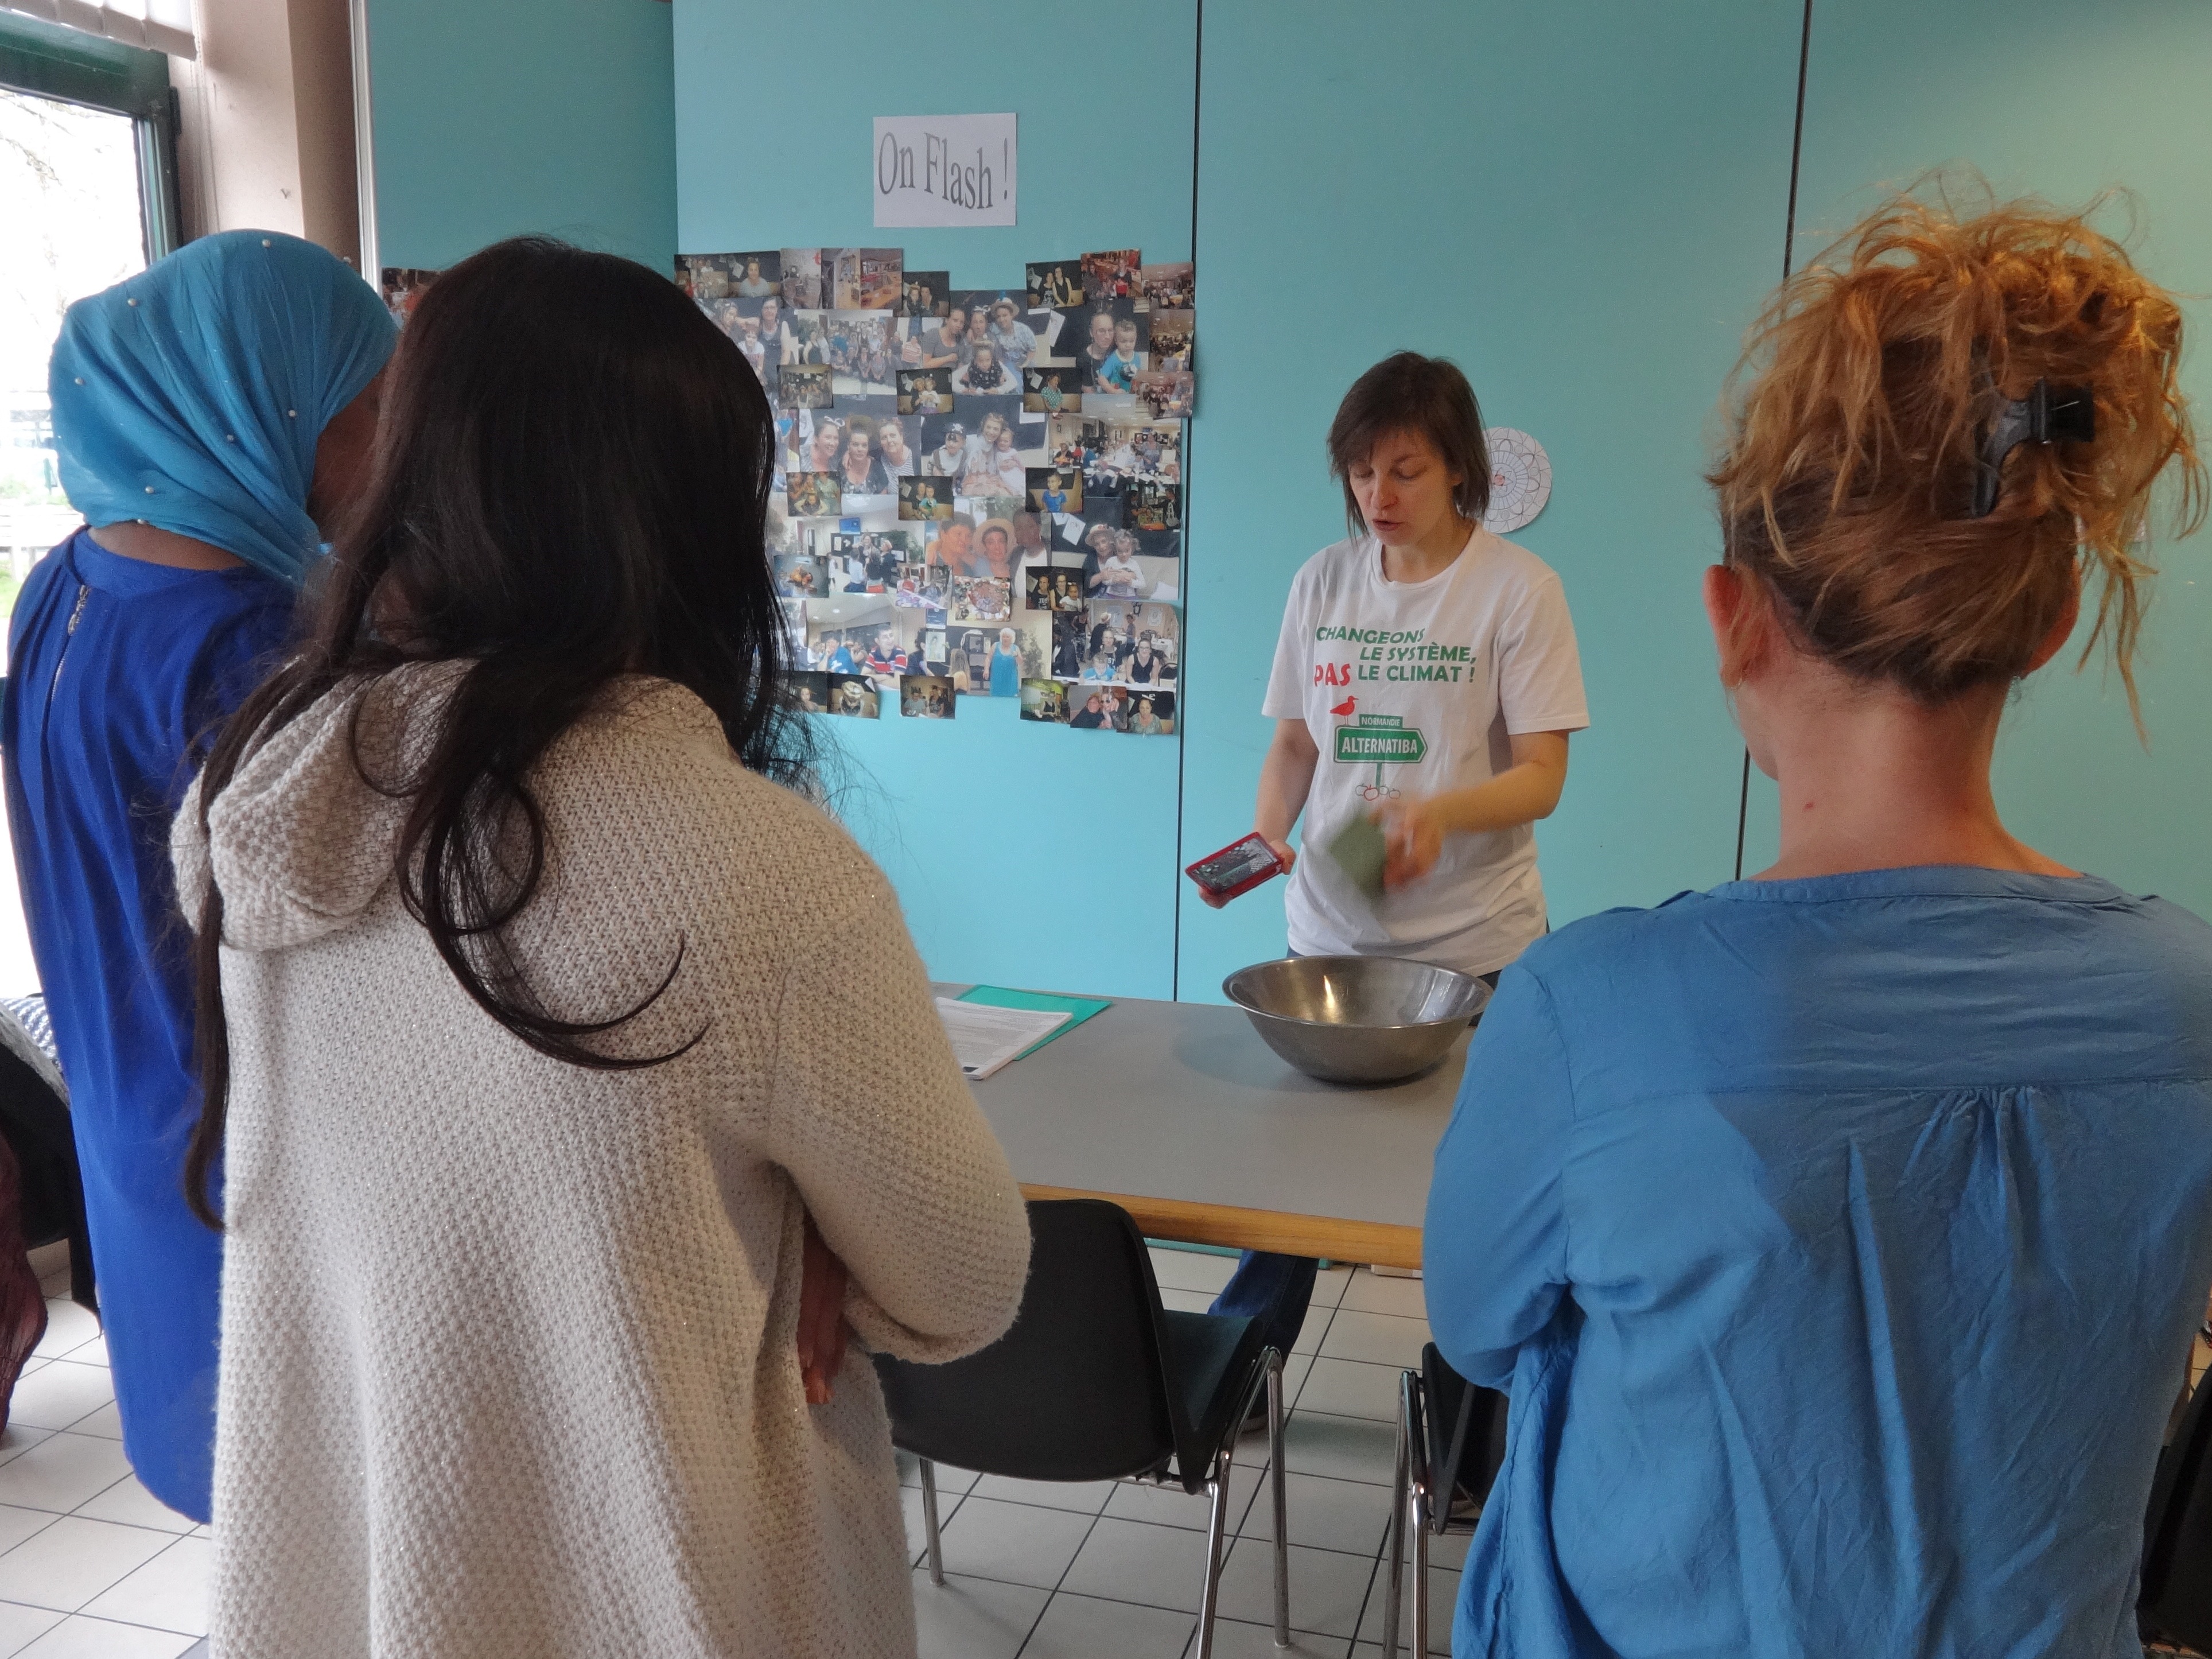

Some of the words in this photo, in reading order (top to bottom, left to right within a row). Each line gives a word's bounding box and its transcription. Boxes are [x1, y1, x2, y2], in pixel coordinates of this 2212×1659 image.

[878, 131, 916, 195] On
[923, 132, 993, 209] Flash
[1316, 626, 1426, 644] CHANGEONS
[1359, 647, 1383, 661] LE
[1387, 642, 1477, 664] SYSTÈME,
[1314, 663, 1352, 687] PAS
[1358, 665, 1380, 681] LE
[1386, 665, 1463, 682] CLIMAT
[1362, 717, 1401, 726] NORMANDIE
[1342, 737, 1418, 754] ALTERNATIBA
